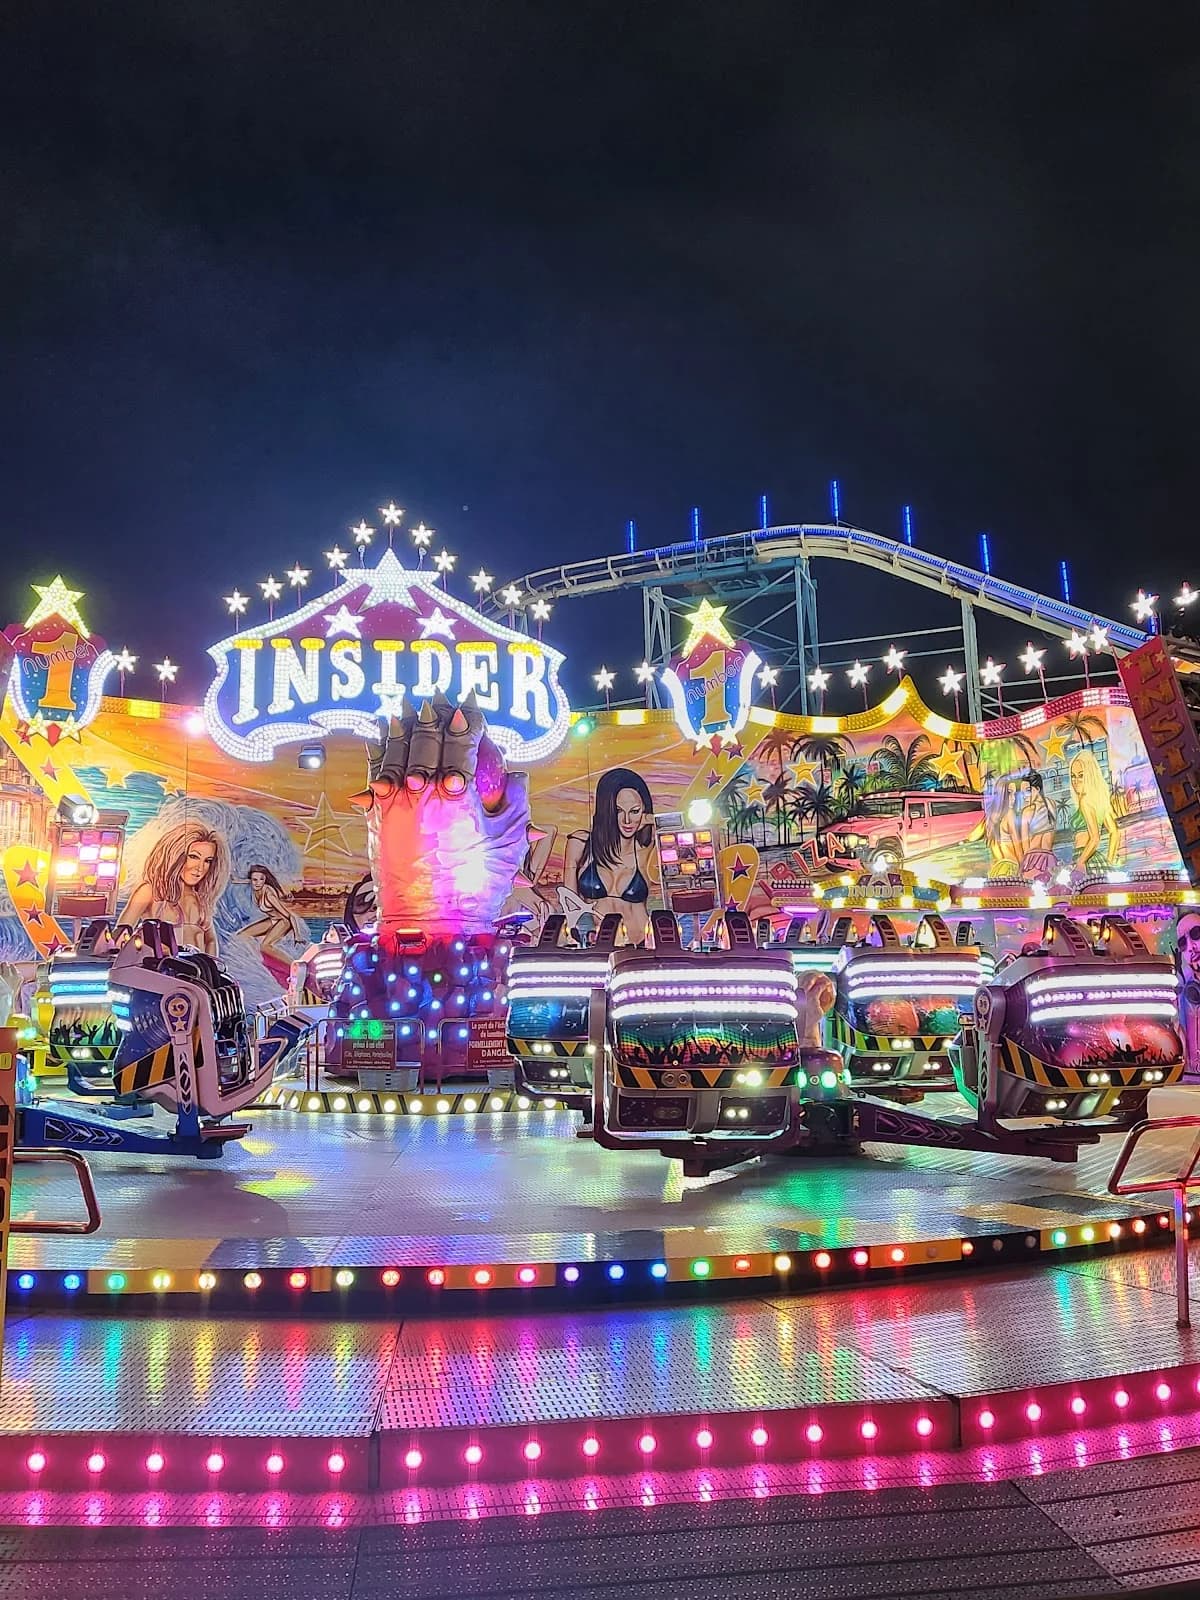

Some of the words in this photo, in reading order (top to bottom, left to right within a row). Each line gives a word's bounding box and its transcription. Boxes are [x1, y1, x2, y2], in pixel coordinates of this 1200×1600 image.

[22, 641, 90, 675] number
[31, 631, 79, 711] 1
[231, 637, 556, 729] INSIDER
[686, 656, 742, 705] number
[689, 649, 733, 726] 1
